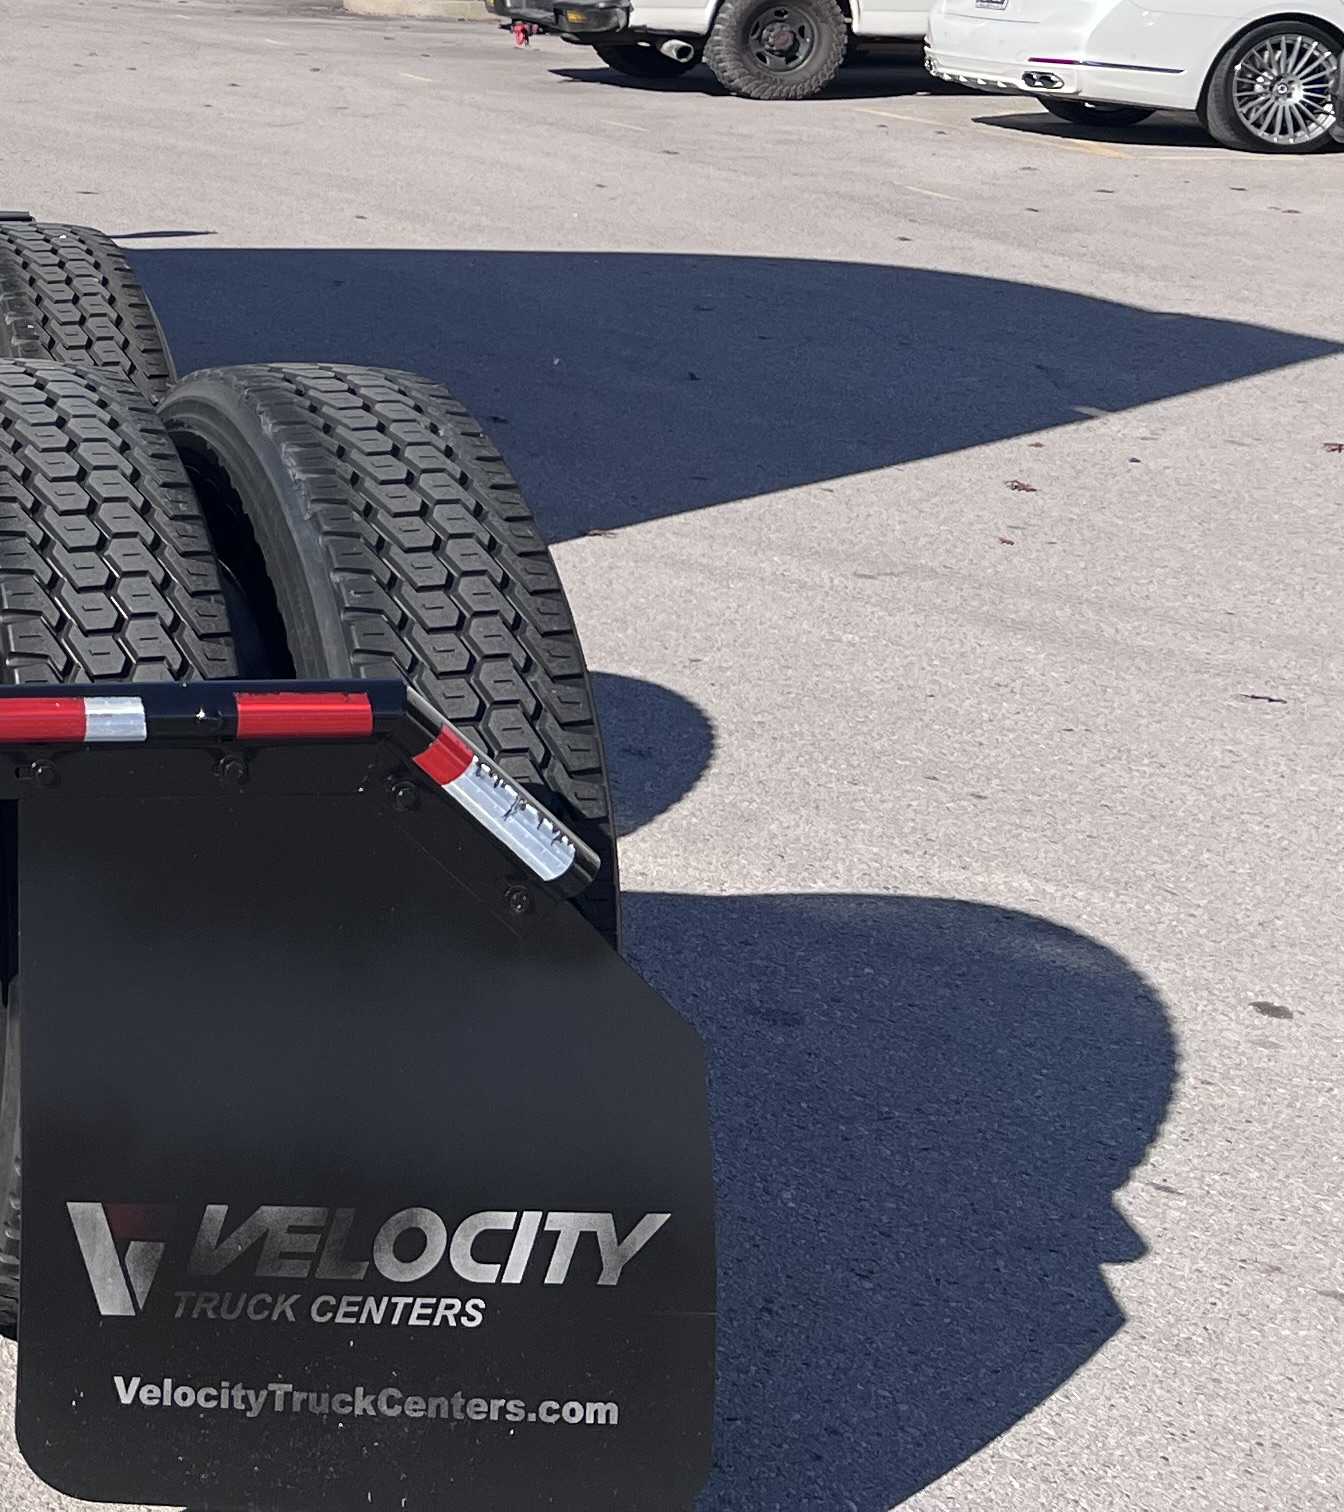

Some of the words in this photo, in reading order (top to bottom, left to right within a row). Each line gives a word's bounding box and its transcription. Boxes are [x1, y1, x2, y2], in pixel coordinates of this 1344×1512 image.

[187, 1204, 672, 1286] VELOCITY
[173, 1291, 297, 1322] TRUCK
[310, 1294, 486, 1327] CENTERS
[113, 1375, 619, 1426] VelocityTruckCenters.com
